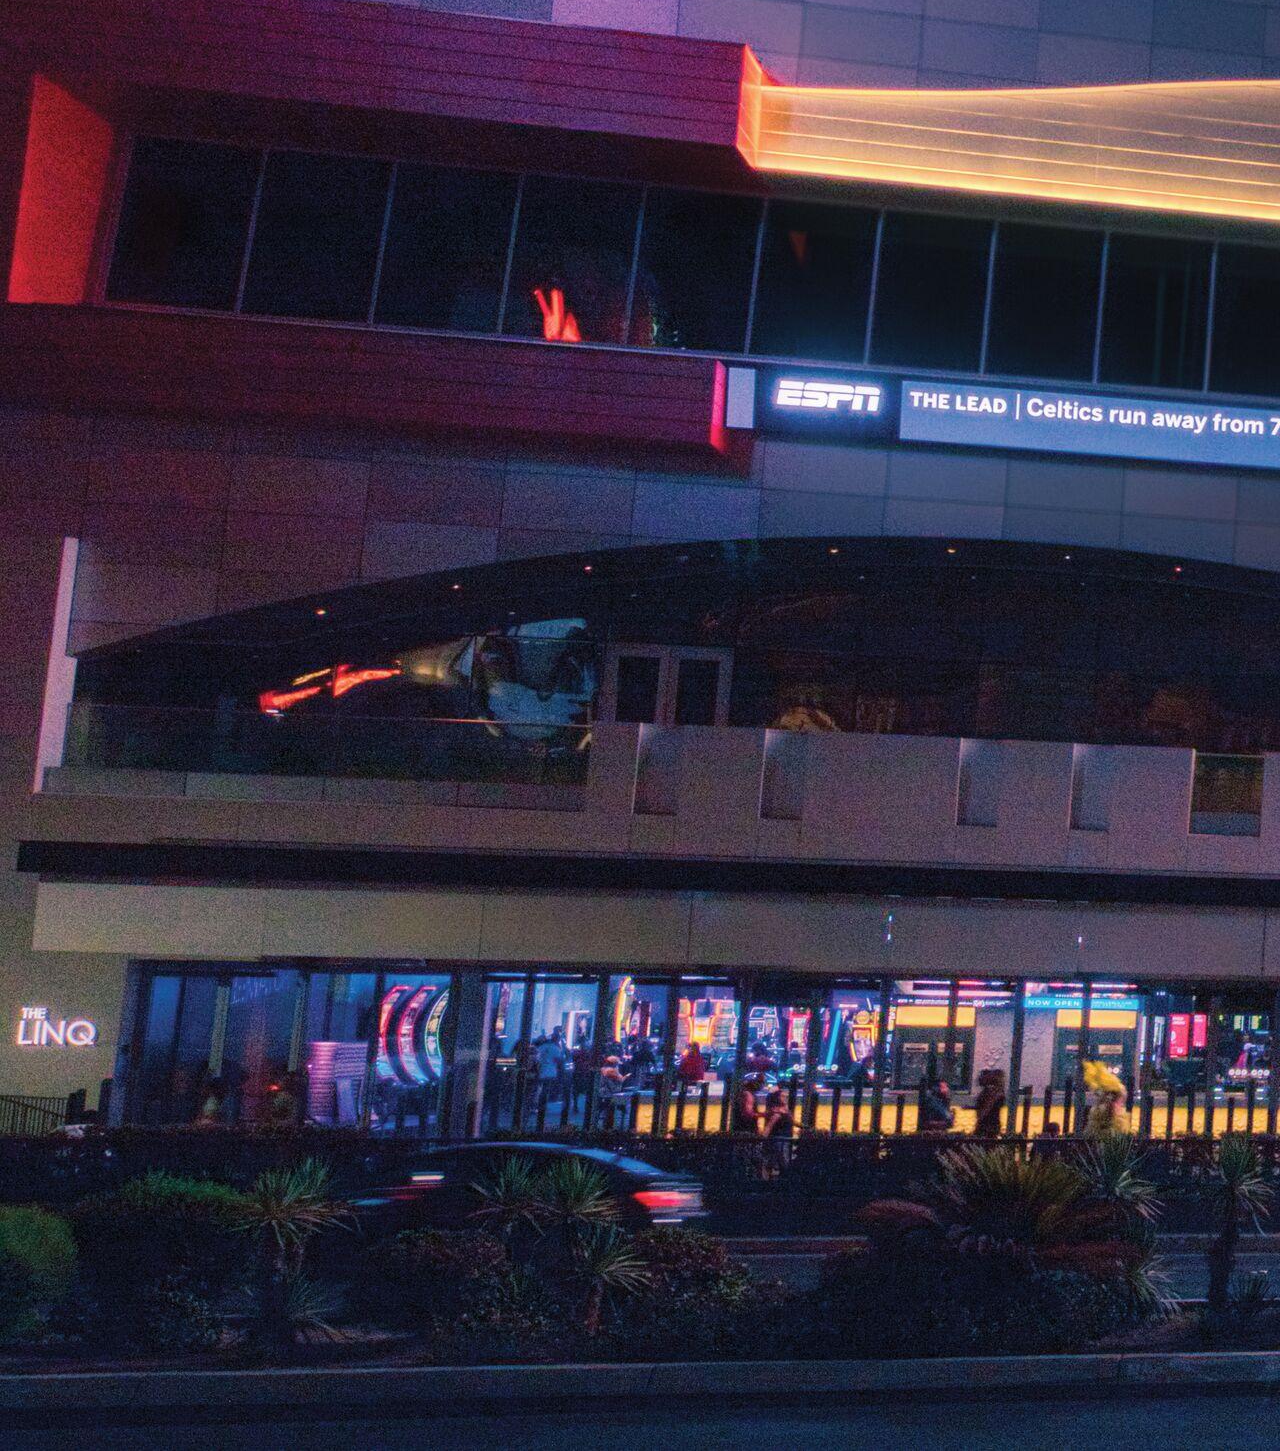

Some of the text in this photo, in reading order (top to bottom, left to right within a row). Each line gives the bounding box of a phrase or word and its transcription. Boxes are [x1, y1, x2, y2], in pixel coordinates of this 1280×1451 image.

[776, 379, 881, 412] ESPN
[910, 391, 950, 411] THE
[955, 395, 1007, 415] LEAD
[1027, 397, 1104, 423] Celtics
[1108, 407, 1147, 426] run
[1151, 409, 1206, 434] away
[1211, 412, 1265, 435] from
[22, 1007, 48, 1019] THE
[1027, 998, 1051, 1008] NOW
[1054, 999, 1081, 1008] OPEN
[17, 1020, 96, 1046] LINQ
